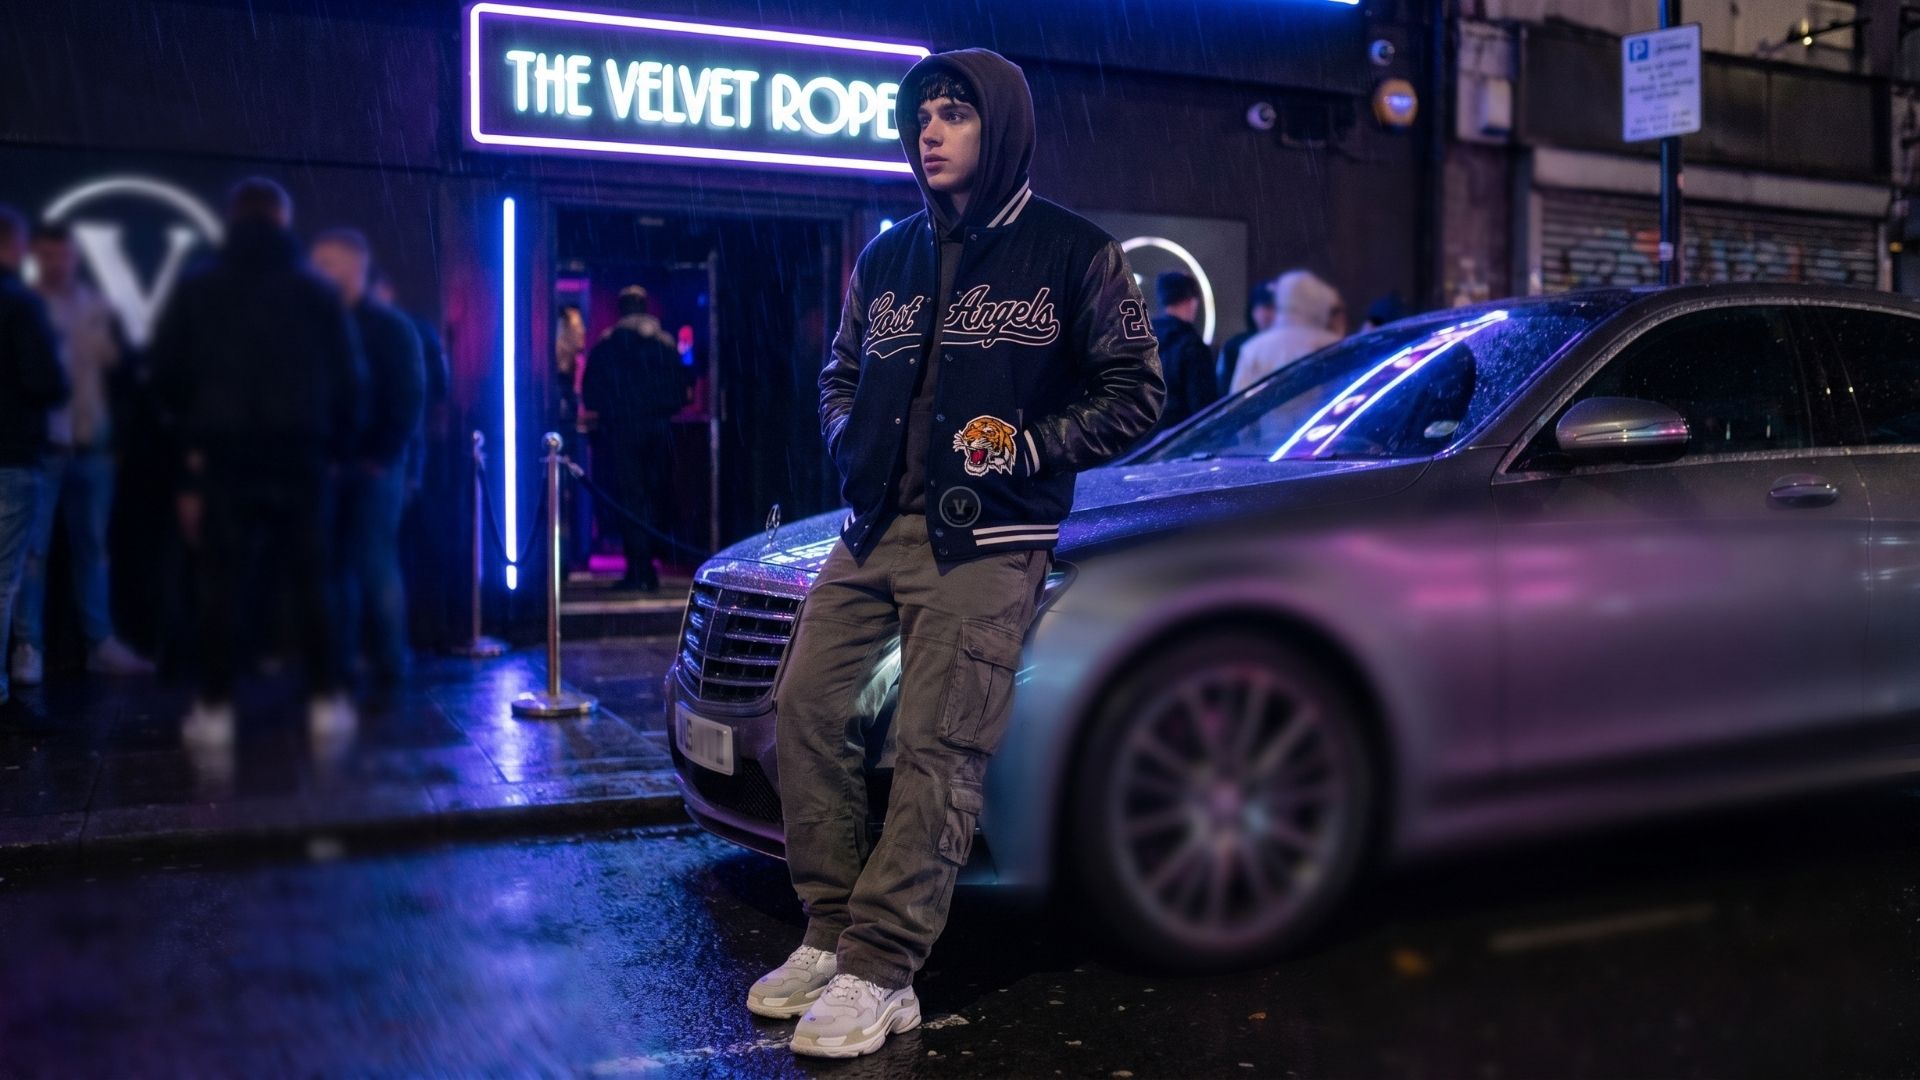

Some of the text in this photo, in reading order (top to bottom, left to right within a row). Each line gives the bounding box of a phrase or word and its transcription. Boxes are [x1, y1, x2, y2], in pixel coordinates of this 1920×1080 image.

[506, 50, 899, 139] THE VELVET ROPE
[73, 223, 196, 346] V
[863, 284, 1058, 347] Lost Angels
